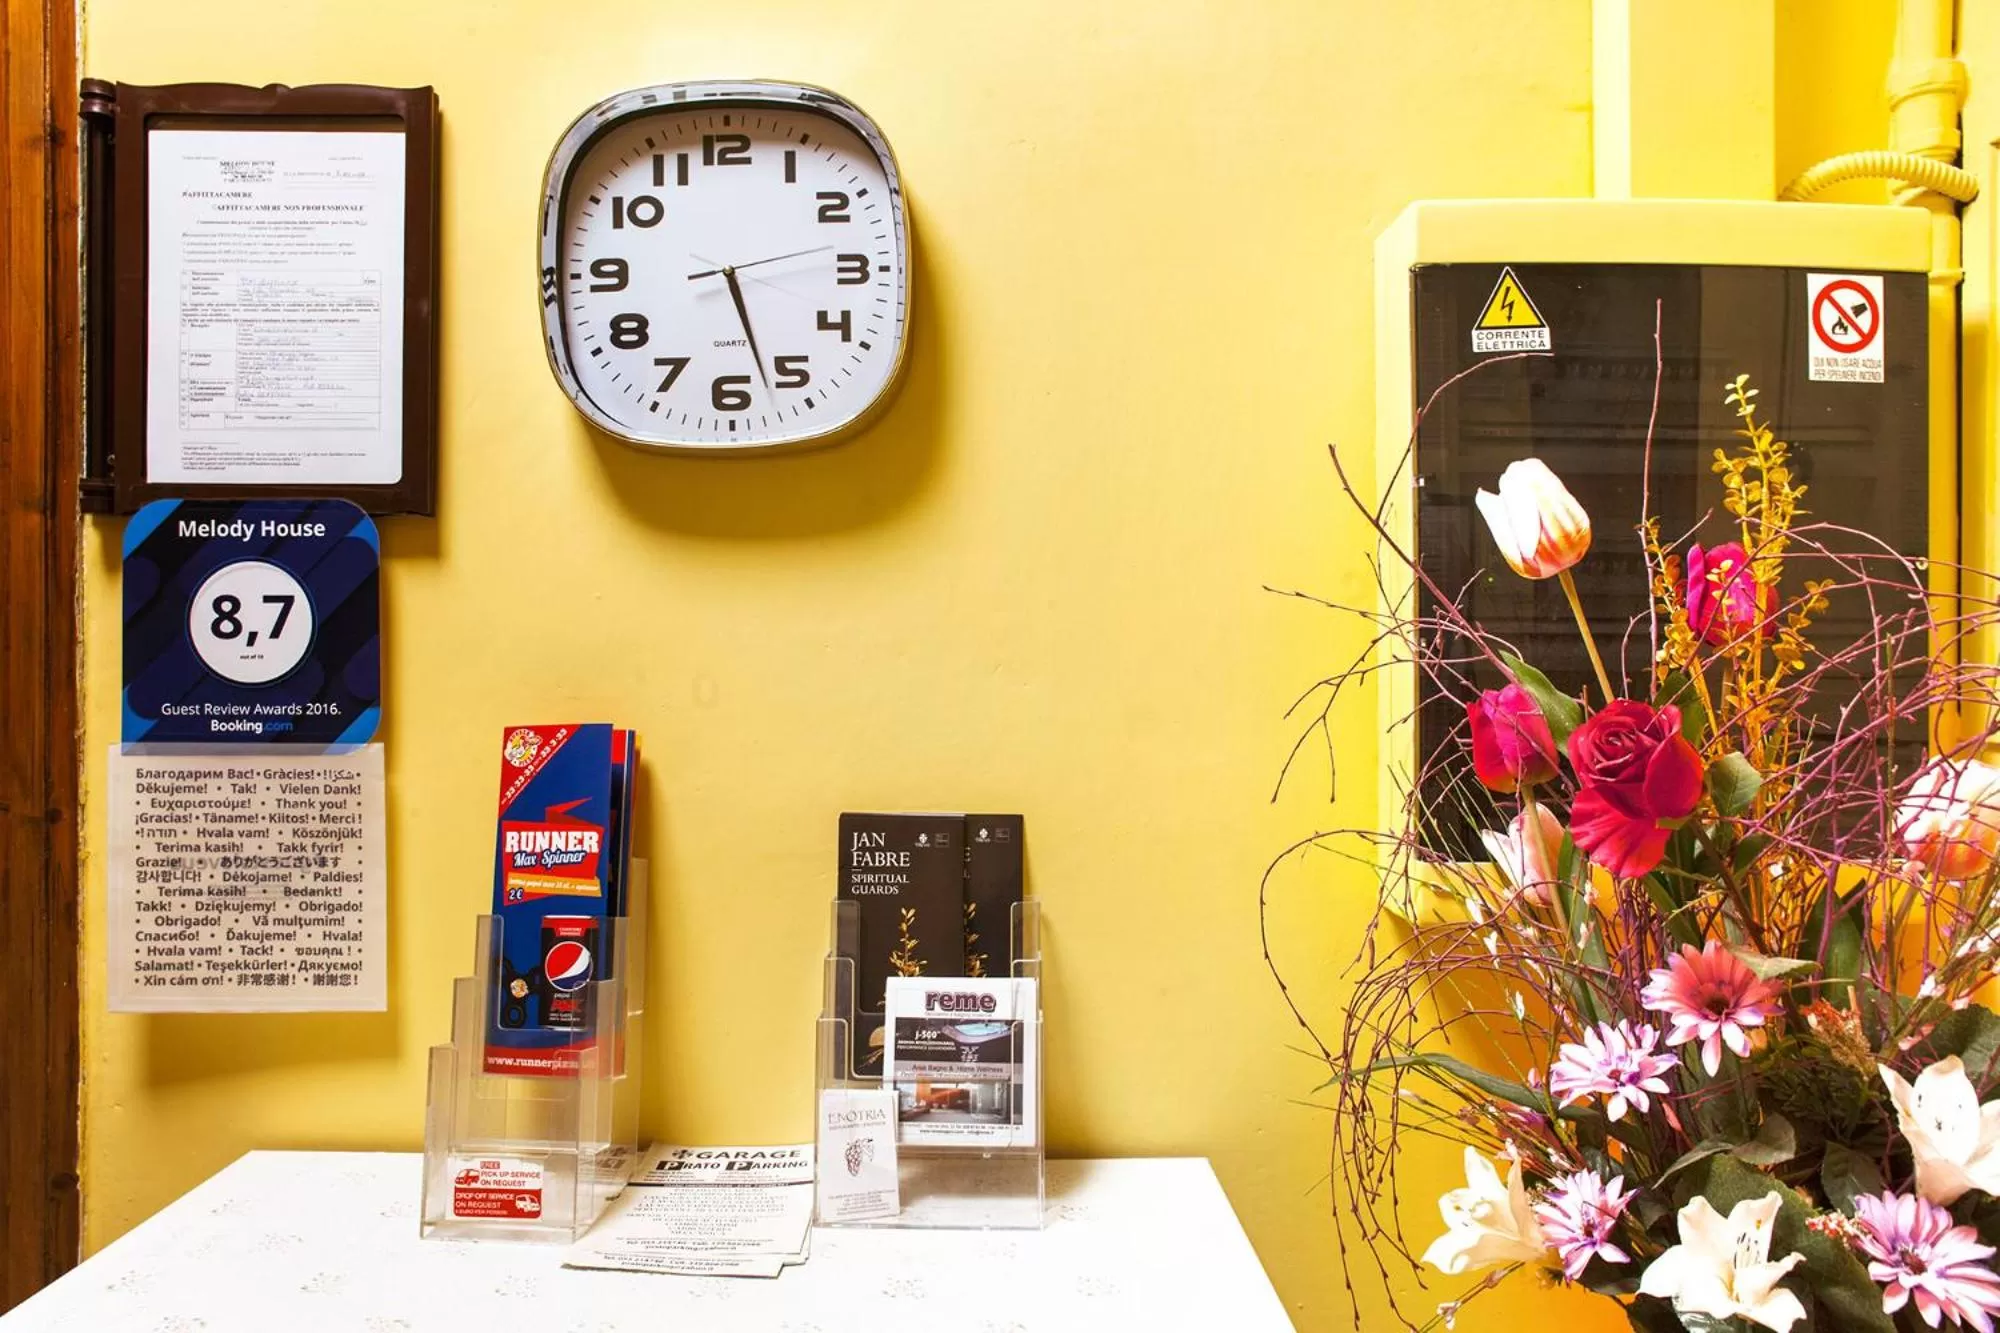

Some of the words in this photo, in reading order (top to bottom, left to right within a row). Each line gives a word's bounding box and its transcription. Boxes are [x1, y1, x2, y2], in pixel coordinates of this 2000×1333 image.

[702, 134, 752, 166] 12
[653, 153, 688, 186] 11
[785, 151, 796, 183] 1
[612, 195, 664, 229] 10
[816, 192, 850, 223] 2
[589, 258, 629, 292] 9
[837, 254, 870, 285] 3
[610, 313, 649, 349] 8
[817, 310, 851, 342] 4
[1477, 330, 1544, 340] CORRENTE
[713, 340, 747, 348] QUARTZ
[1477, 340, 1546, 350] ELETTRICA
[654, 357, 691, 392] 7
[774, 355, 810, 388] 5
[711, 375, 751, 411] 6
[179, 520, 255, 542] Melody
[261, 520, 325, 537] House
[210, 595, 295, 647] 8,7
[161, 703, 200, 715] Guest
[204, 703, 250, 715] Review
[254, 703, 302, 715] Awards
[306, 703, 341, 715] 2016.
[211, 720, 293, 734] Booking.com
[136, 769, 223, 781] Благодарим
[263, 769, 314, 779] Gràcies!
[136, 783, 207, 796] Děkujeme!
[231, 784, 256, 794] Tak!
[280, 784, 319, 794] Vielen
[323, 784, 361, 794] Dank!
[276, 799, 315, 809] Thank
[319, 800, 347, 811] you!
[135, 813, 192, 825] ¡Gracias!
[203, 813, 258, 823] Täname!
[269, 813, 308, 823] Kiitos!
[197, 828, 233, 838] Hvala
[238, 828, 269, 838] vam!
[292, 828, 362, 841] Köszönjük!
[505, 832, 599, 853] RUNNER
[851, 832, 885, 851] JAN
[156, 843, 200, 853] Terima
[205, 843, 243, 853] kasih!
[276, 843, 307, 853] Takk
[311, 843, 343, 855] fyrir!
[136, 857, 181, 868] Grazie!
[220, 856, 341, 868] ありがとうございます
[514, 852, 537, 867] Max
[541, 850, 586, 868] Spinner
[852, 852, 911, 867] FABRE
[136, 871, 201, 883] 감사합니다!
[313, 872, 362, 882] Paldies!
[852, 874, 909, 884] SPIRITUAL
[158, 887, 203, 897] Terima
[207, 887, 246, 897] kasih!
[284, 887, 342, 897] Bedankt!
[852, 885, 899, 895] GUARDS
[136, 902, 171, 912] Takk!
[195, 902, 276, 915] Dziękujemy!
[299, 902, 362, 914] Obrigado!
[155, 916, 221, 929] Obrigado!
[252, 916, 269, 927] Vă
[135, 931, 199, 942] Спасибо!
[226, 929, 296, 943] Ďakujeme!
[322, 931, 362, 942] Hvala!
[147, 946, 186, 956] Hvala
[190, 946, 221, 956] vam!
[240, 946, 273, 956] Tack!
[135, 961, 194, 971] Salamat!
[205, 961, 287, 974] Teşekkürler!
[298, 961, 362, 973] Дякуємо!
[144, 975, 166, 986] Xin
[925, 992, 996, 1012] reme
[696, 1150, 801, 1159] GARAGE
[656, 1161, 720, 1170] PRATO
[726, 1161, 808, 1170] PARKING
[511, 1171, 540, 1179] SERVICE
[493, 1179, 525, 1187] REQUEST
